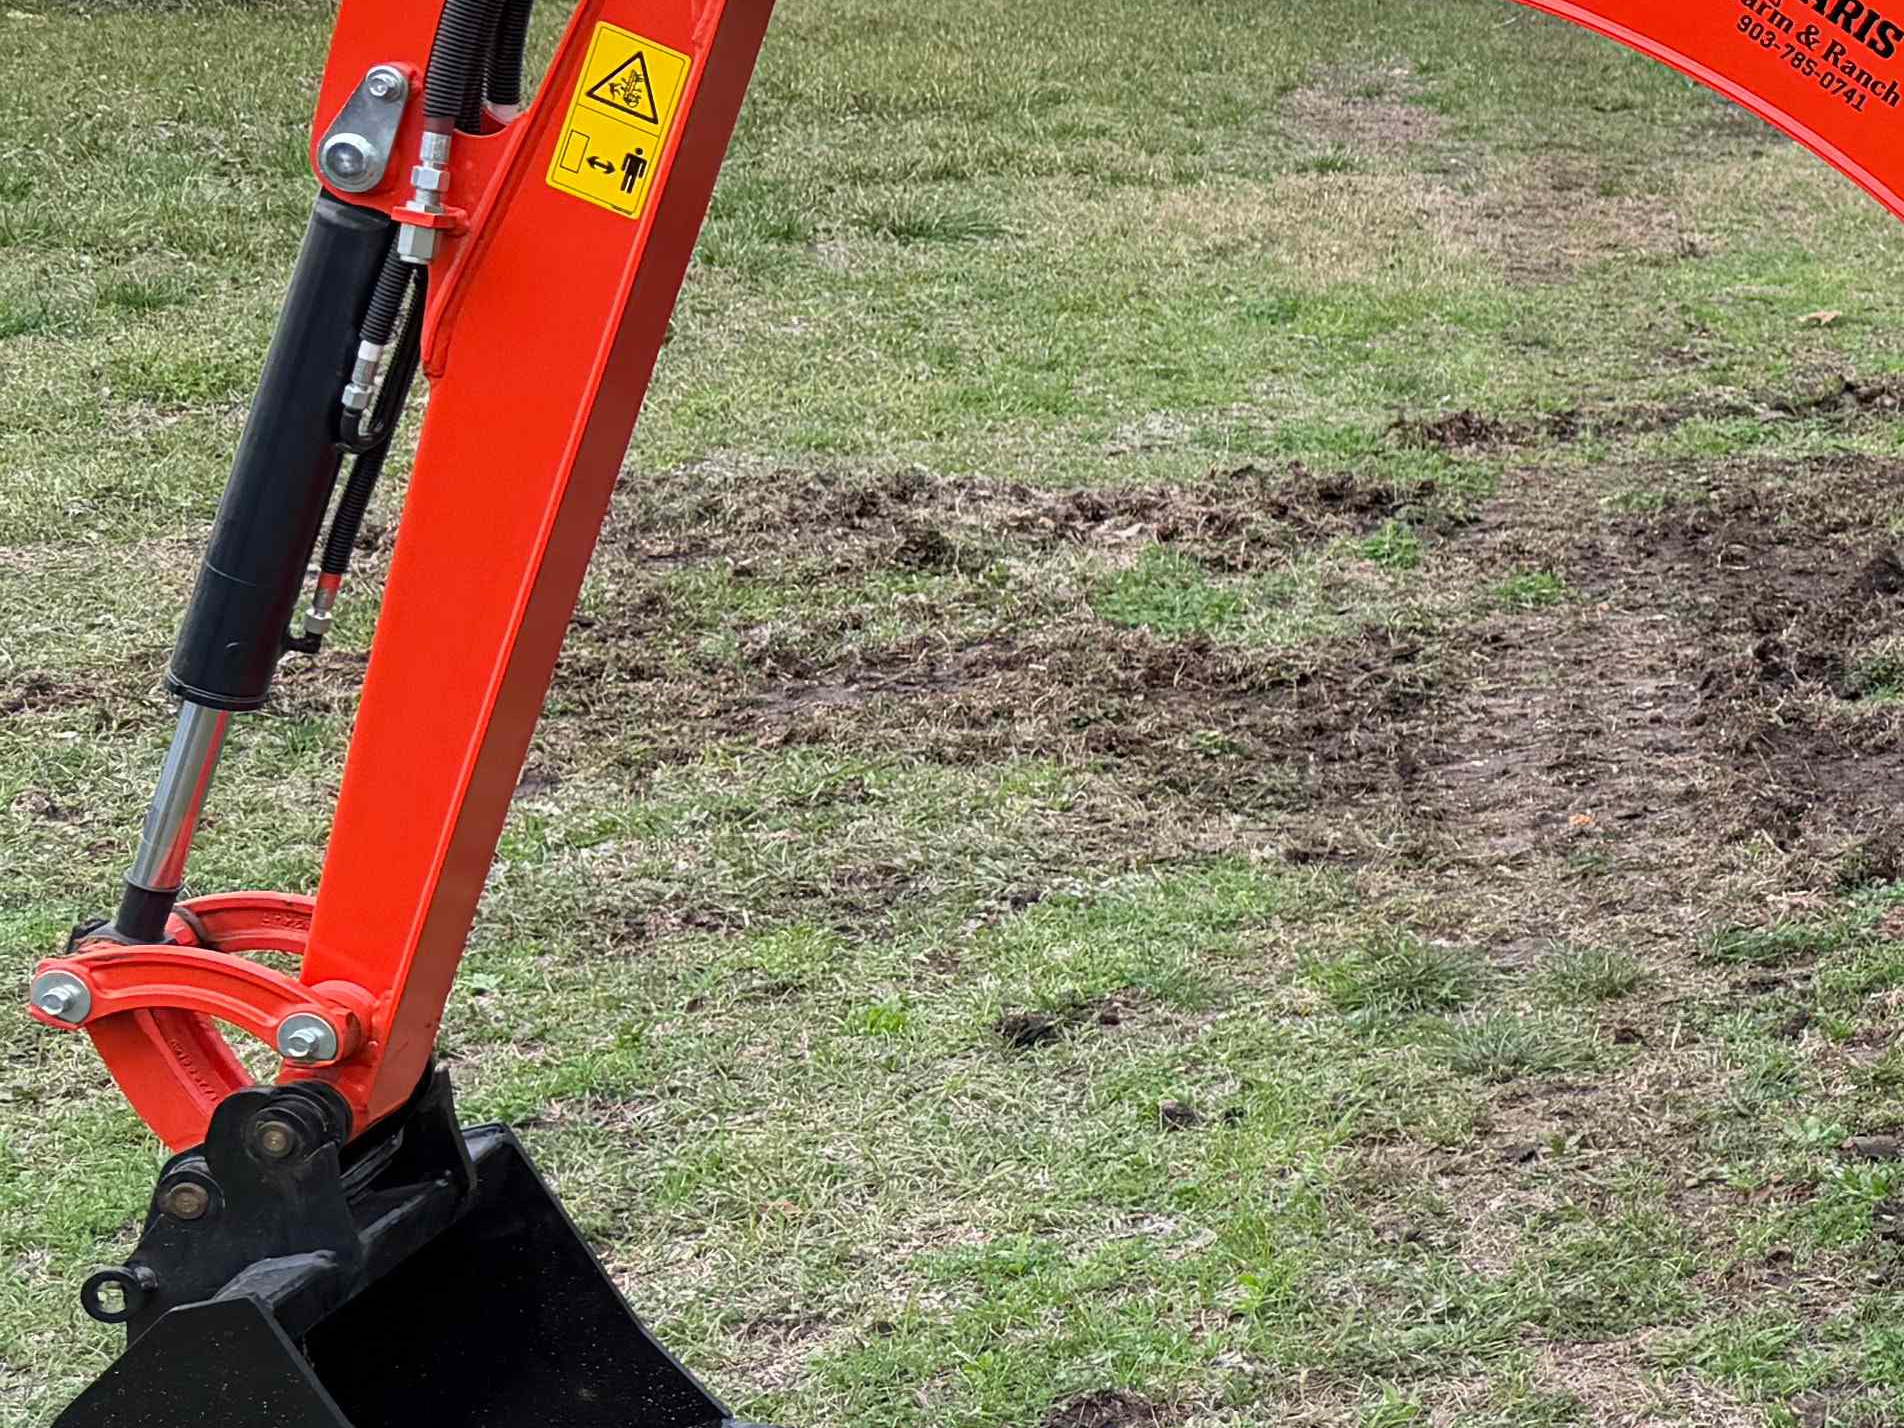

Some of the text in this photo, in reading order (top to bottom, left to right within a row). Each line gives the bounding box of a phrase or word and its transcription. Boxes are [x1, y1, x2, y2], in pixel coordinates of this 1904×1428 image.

[1737, 14, 1868, 112] 903-785-0741
[1796, 24, 1821, 52] &
[1821, 38, 1901, 107] Ranch
